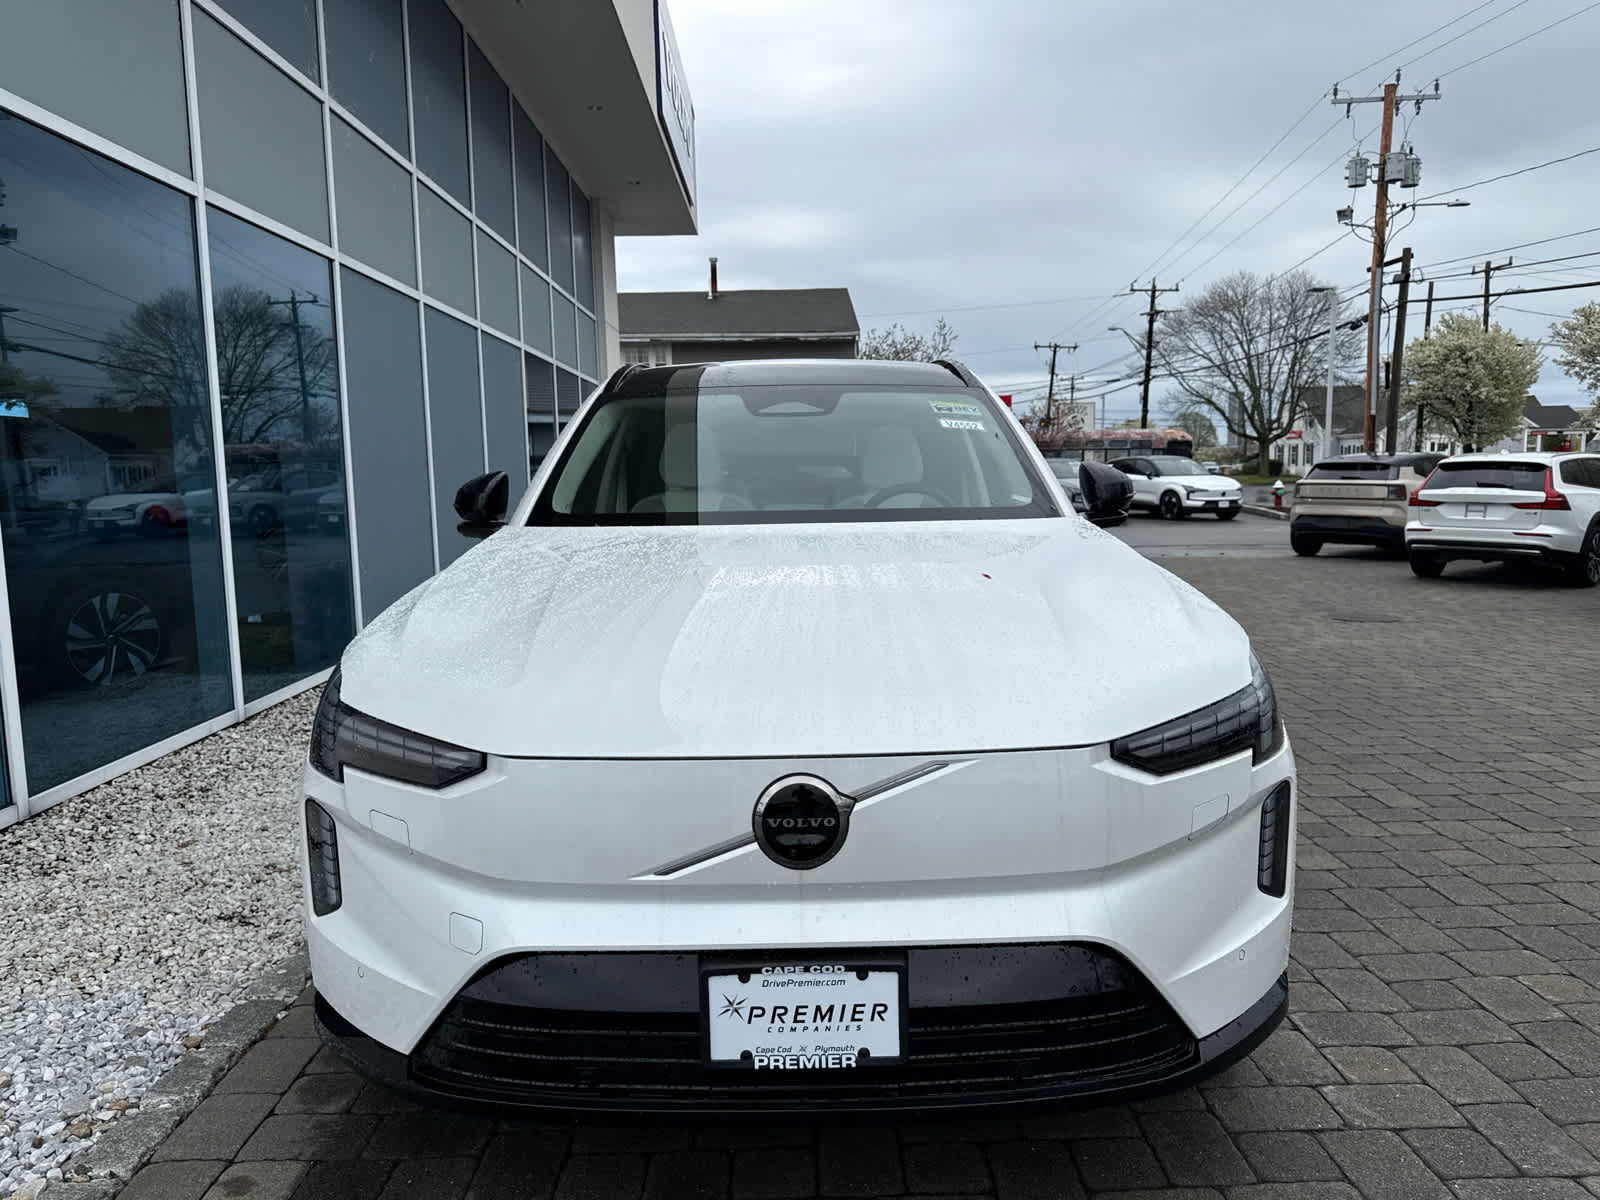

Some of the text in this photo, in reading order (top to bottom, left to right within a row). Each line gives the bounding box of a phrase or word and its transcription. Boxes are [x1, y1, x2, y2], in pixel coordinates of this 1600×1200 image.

[766, 817, 836, 828] VOLVO
[761, 965, 845, 975] CAPE COD
[762, 978, 846, 988] DrivePremier.com
[747, 1003, 889, 1024] PREMIER
[767, 1024, 862, 1033] COMPANIES
[755, 1045, 855, 1054] Cape Cod Plymouth
[754, 1054, 857, 1070] PREMIER
